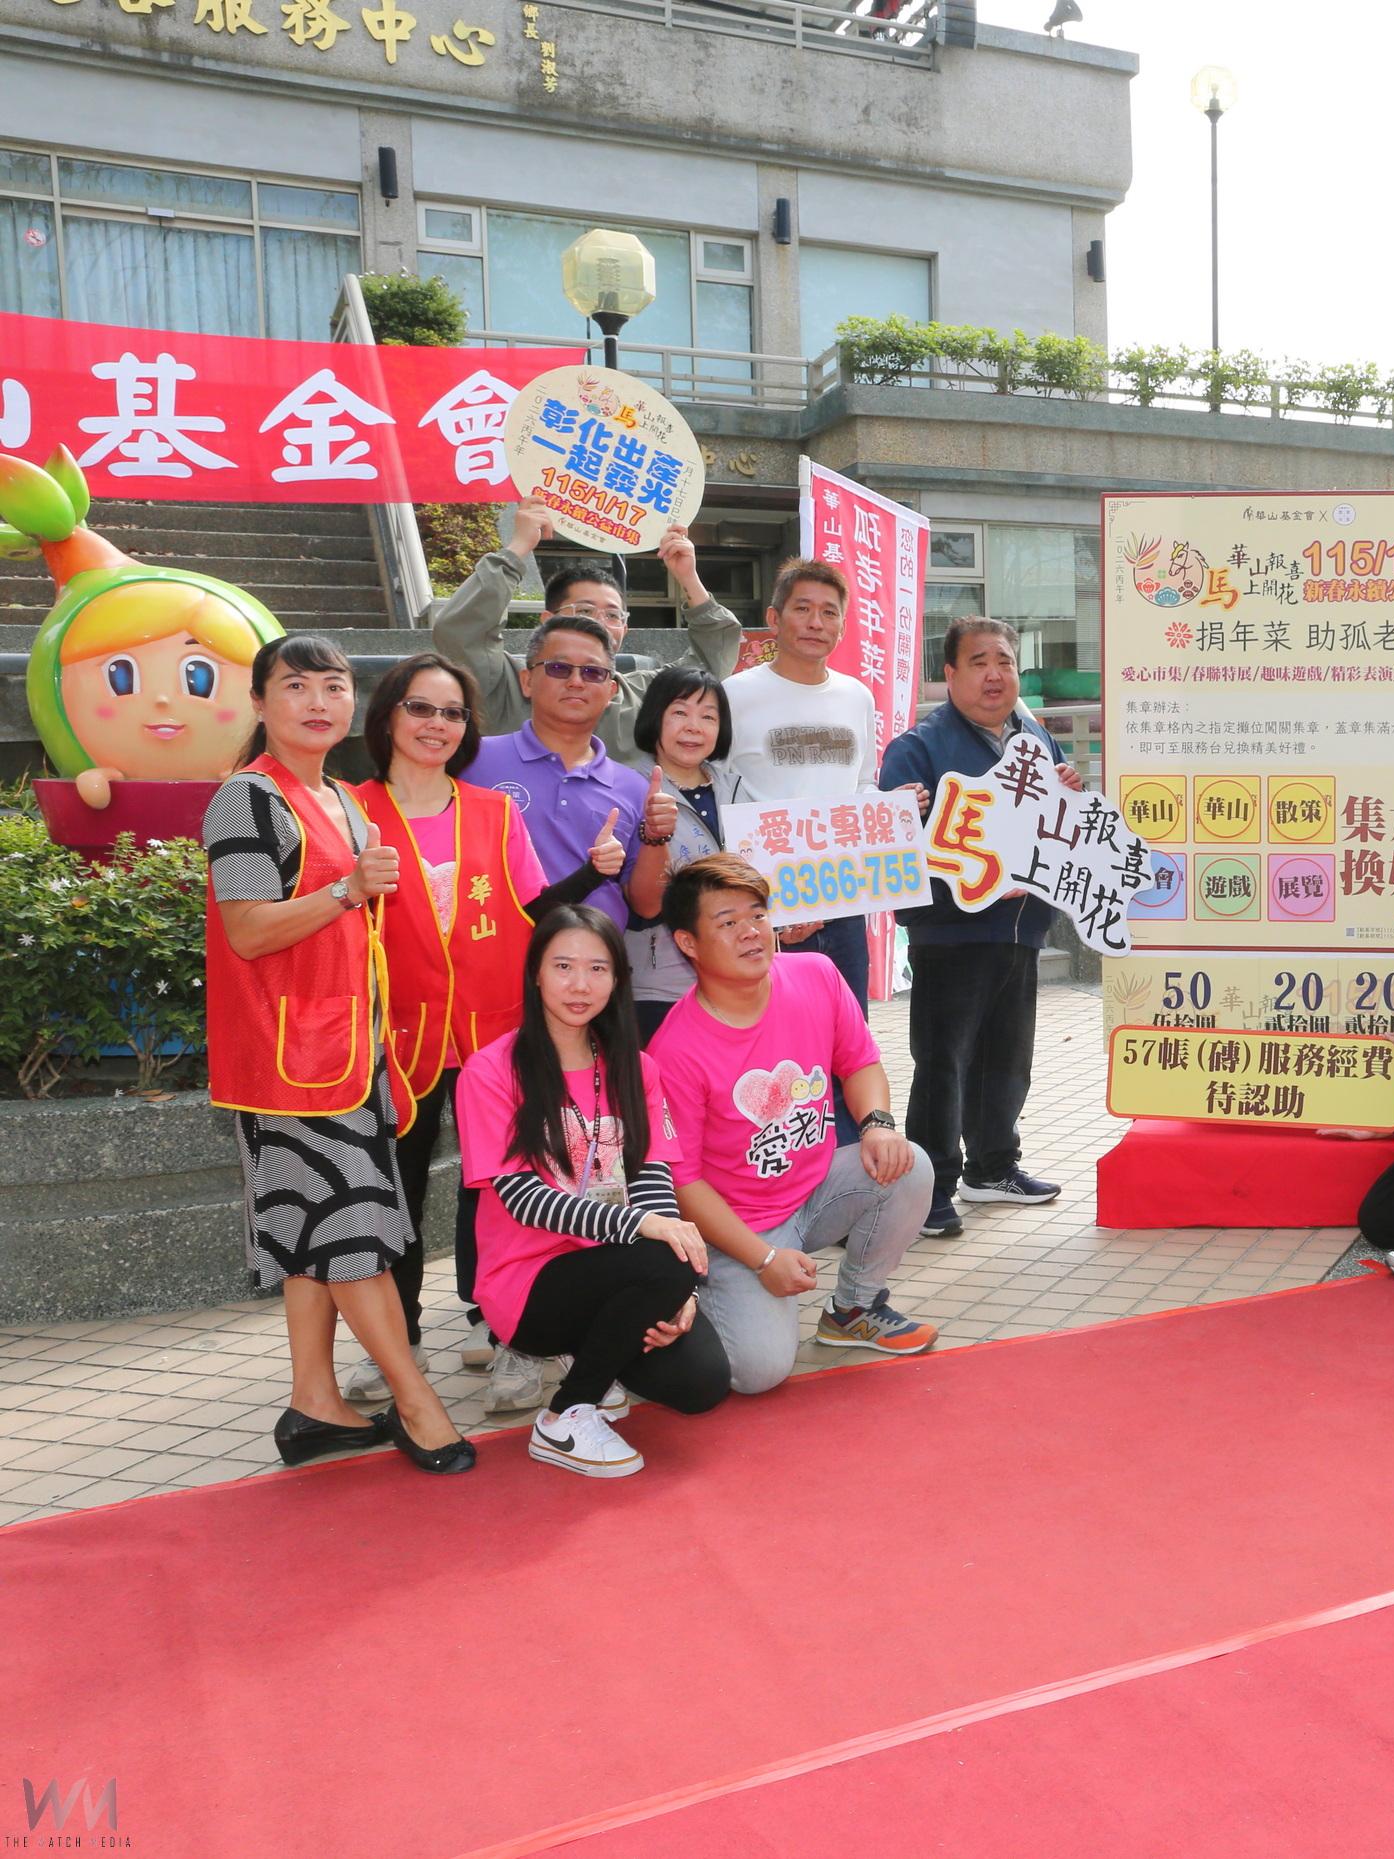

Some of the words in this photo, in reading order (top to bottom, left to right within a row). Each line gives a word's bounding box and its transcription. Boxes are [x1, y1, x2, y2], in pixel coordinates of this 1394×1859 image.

[0, 350, 508, 486] 基金會
[538, 398, 684, 487] 彰化出產
[531, 433, 674, 515] 一起發光
[541, 466, 647, 527] 115/1/17
[1194, 620, 1293, 652] 捐年菜
[1129, 799, 1174, 824] 華山
[1203, 796, 1249, 822] 華山
[1275, 799, 1322, 825] 散策
[758, 801, 897, 857] 愛心專線
[766, 851, 922, 911] -8366-755
[1204, 874, 1251, 900] 遊戲
[1278, 873, 1324, 900] 展覽
[467, 873, 497, 941] 華山
[1162, 971, 1212, 1010] 50
[1273, 971, 1324, 1011] 20
[1206, 1080, 1306, 1119] 待認助
